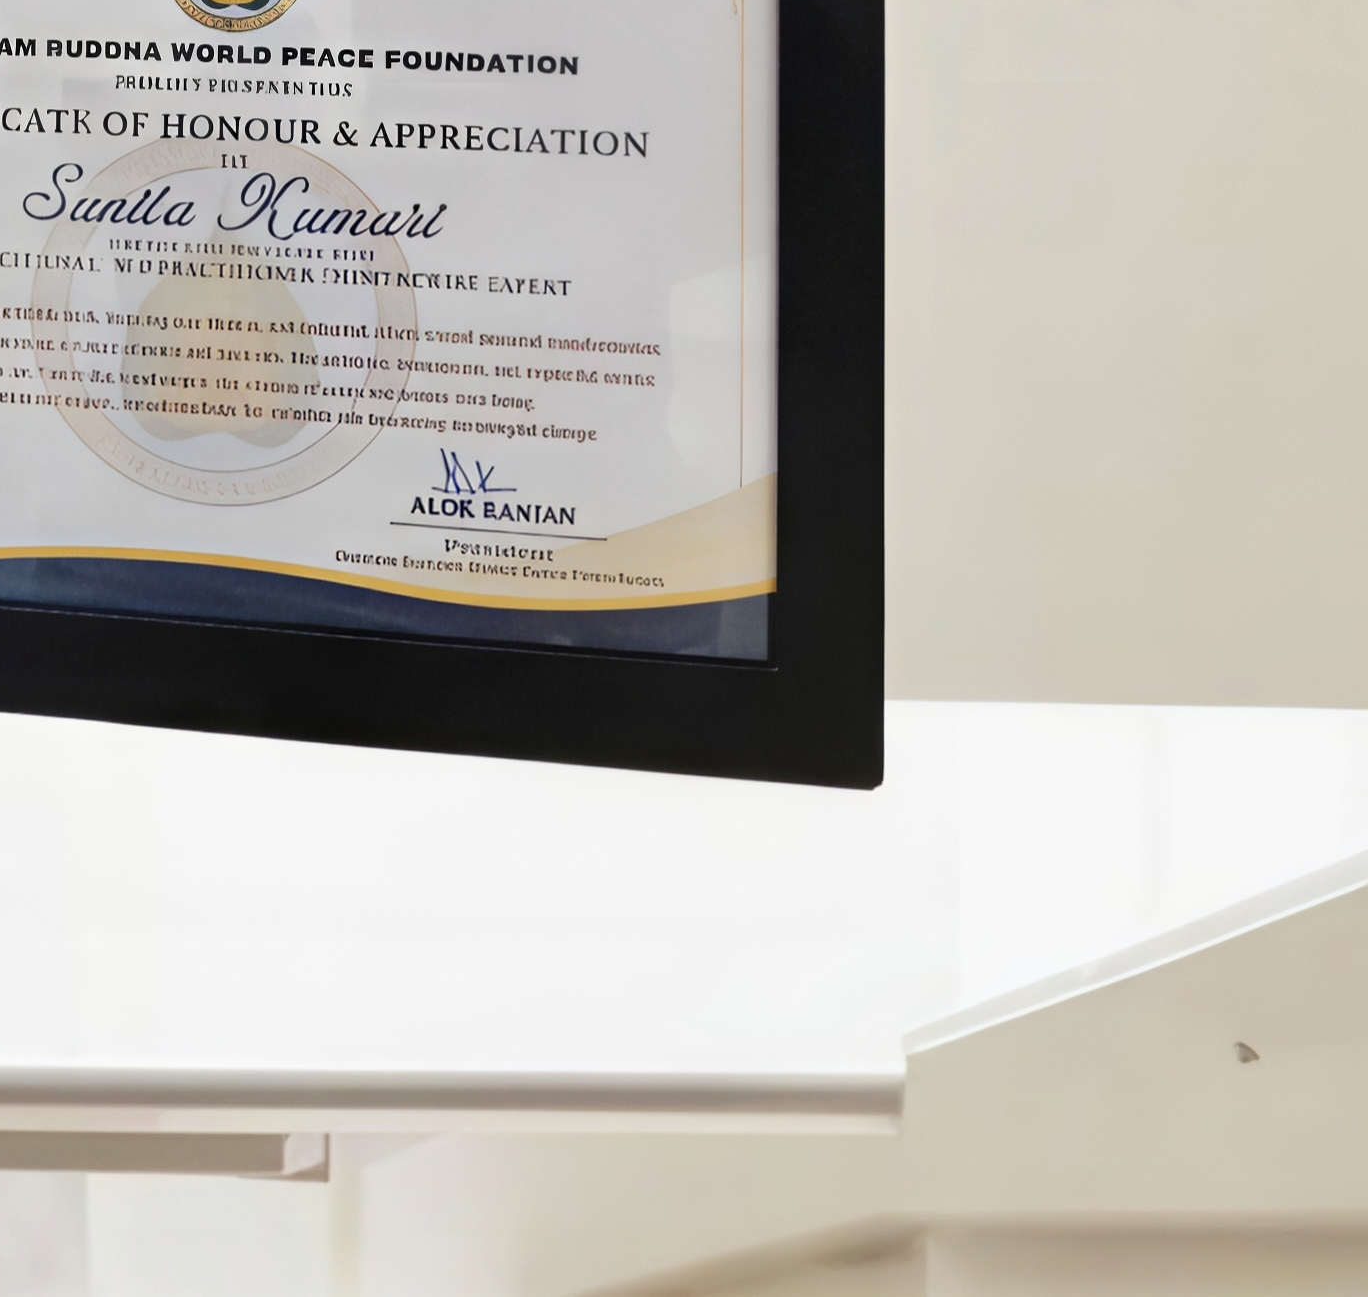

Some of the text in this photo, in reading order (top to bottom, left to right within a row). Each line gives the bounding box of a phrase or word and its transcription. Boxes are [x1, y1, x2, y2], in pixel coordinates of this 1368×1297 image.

[171, 42, 272, 65] WORLD
[281, 46, 374, 69] PEACE
[385, 50, 580, 76] FOUNDATION
[102, 111, 149, 137] OF
[159, 113, 322, 145] HONOUR
[332, 120, 359, 147] &
[369, 121, 650, 159] APPRECIATION
[410, 496, 476, 519] ALOK
